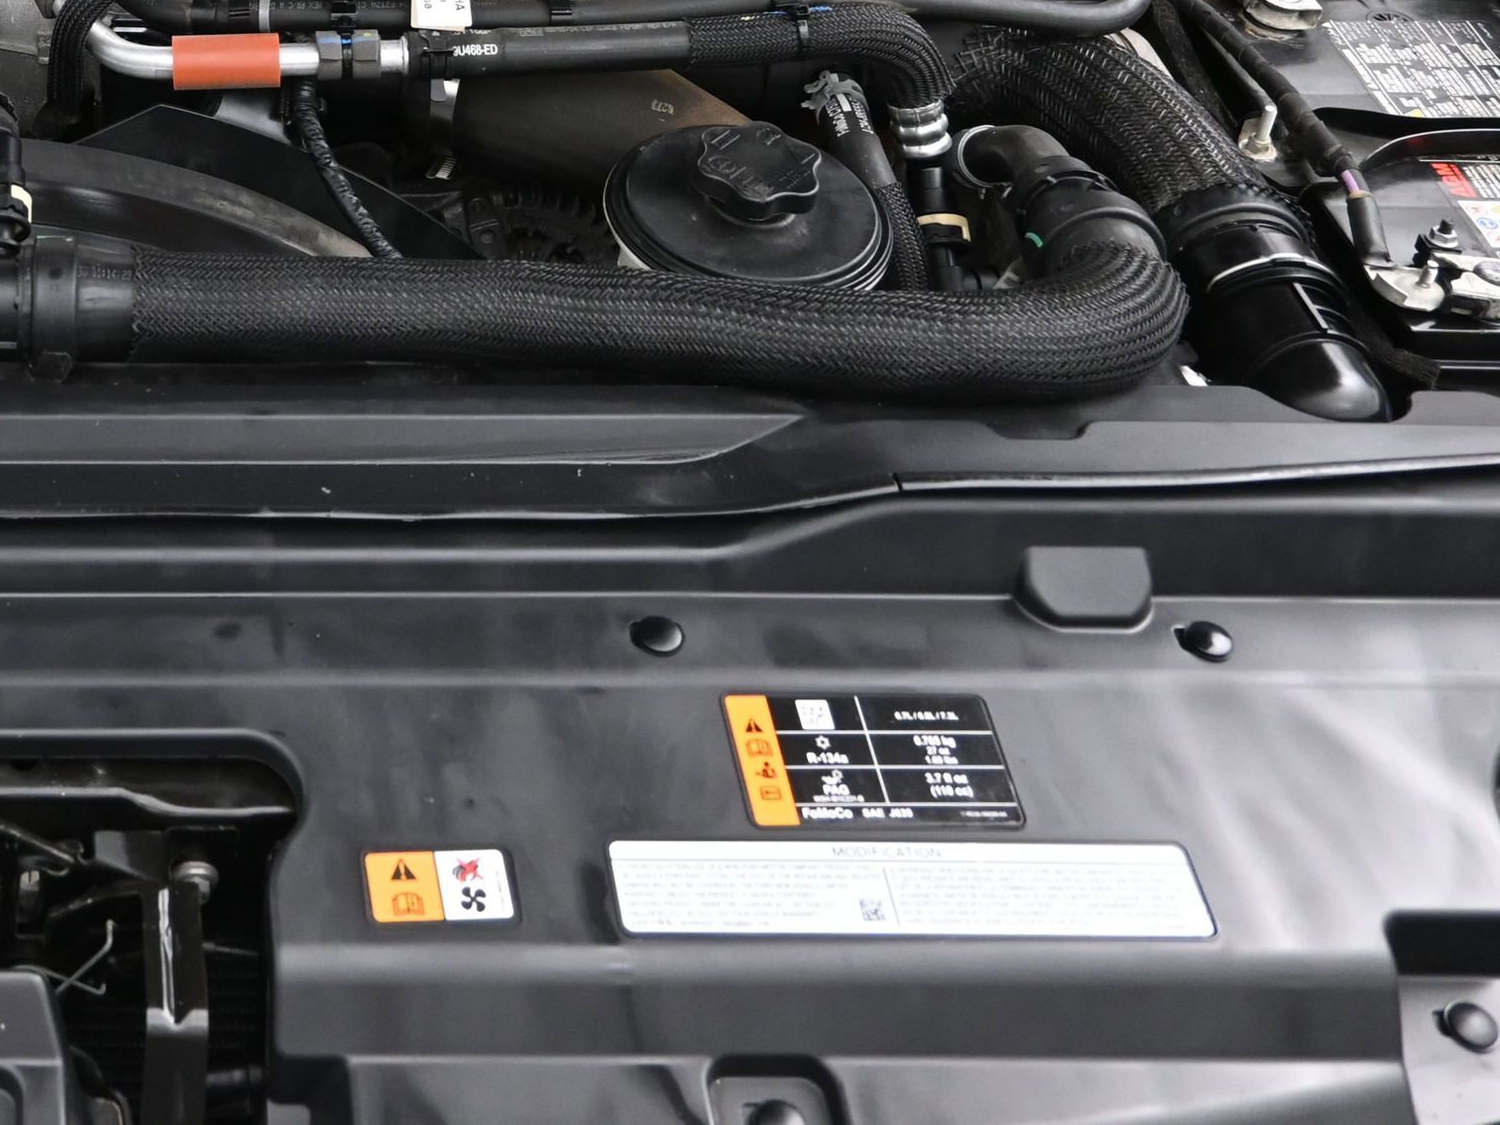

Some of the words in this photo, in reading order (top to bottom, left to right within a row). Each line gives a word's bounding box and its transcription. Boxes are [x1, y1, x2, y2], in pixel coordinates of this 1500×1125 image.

[805, 751, 849, 764] R-134a
[822, 783, 850, 796] PAG
[801, 806, 854, 820] FoMoCo
[861, 807, 886, 819] SAE
[831, 846, 942, 858] MODIFICATION
